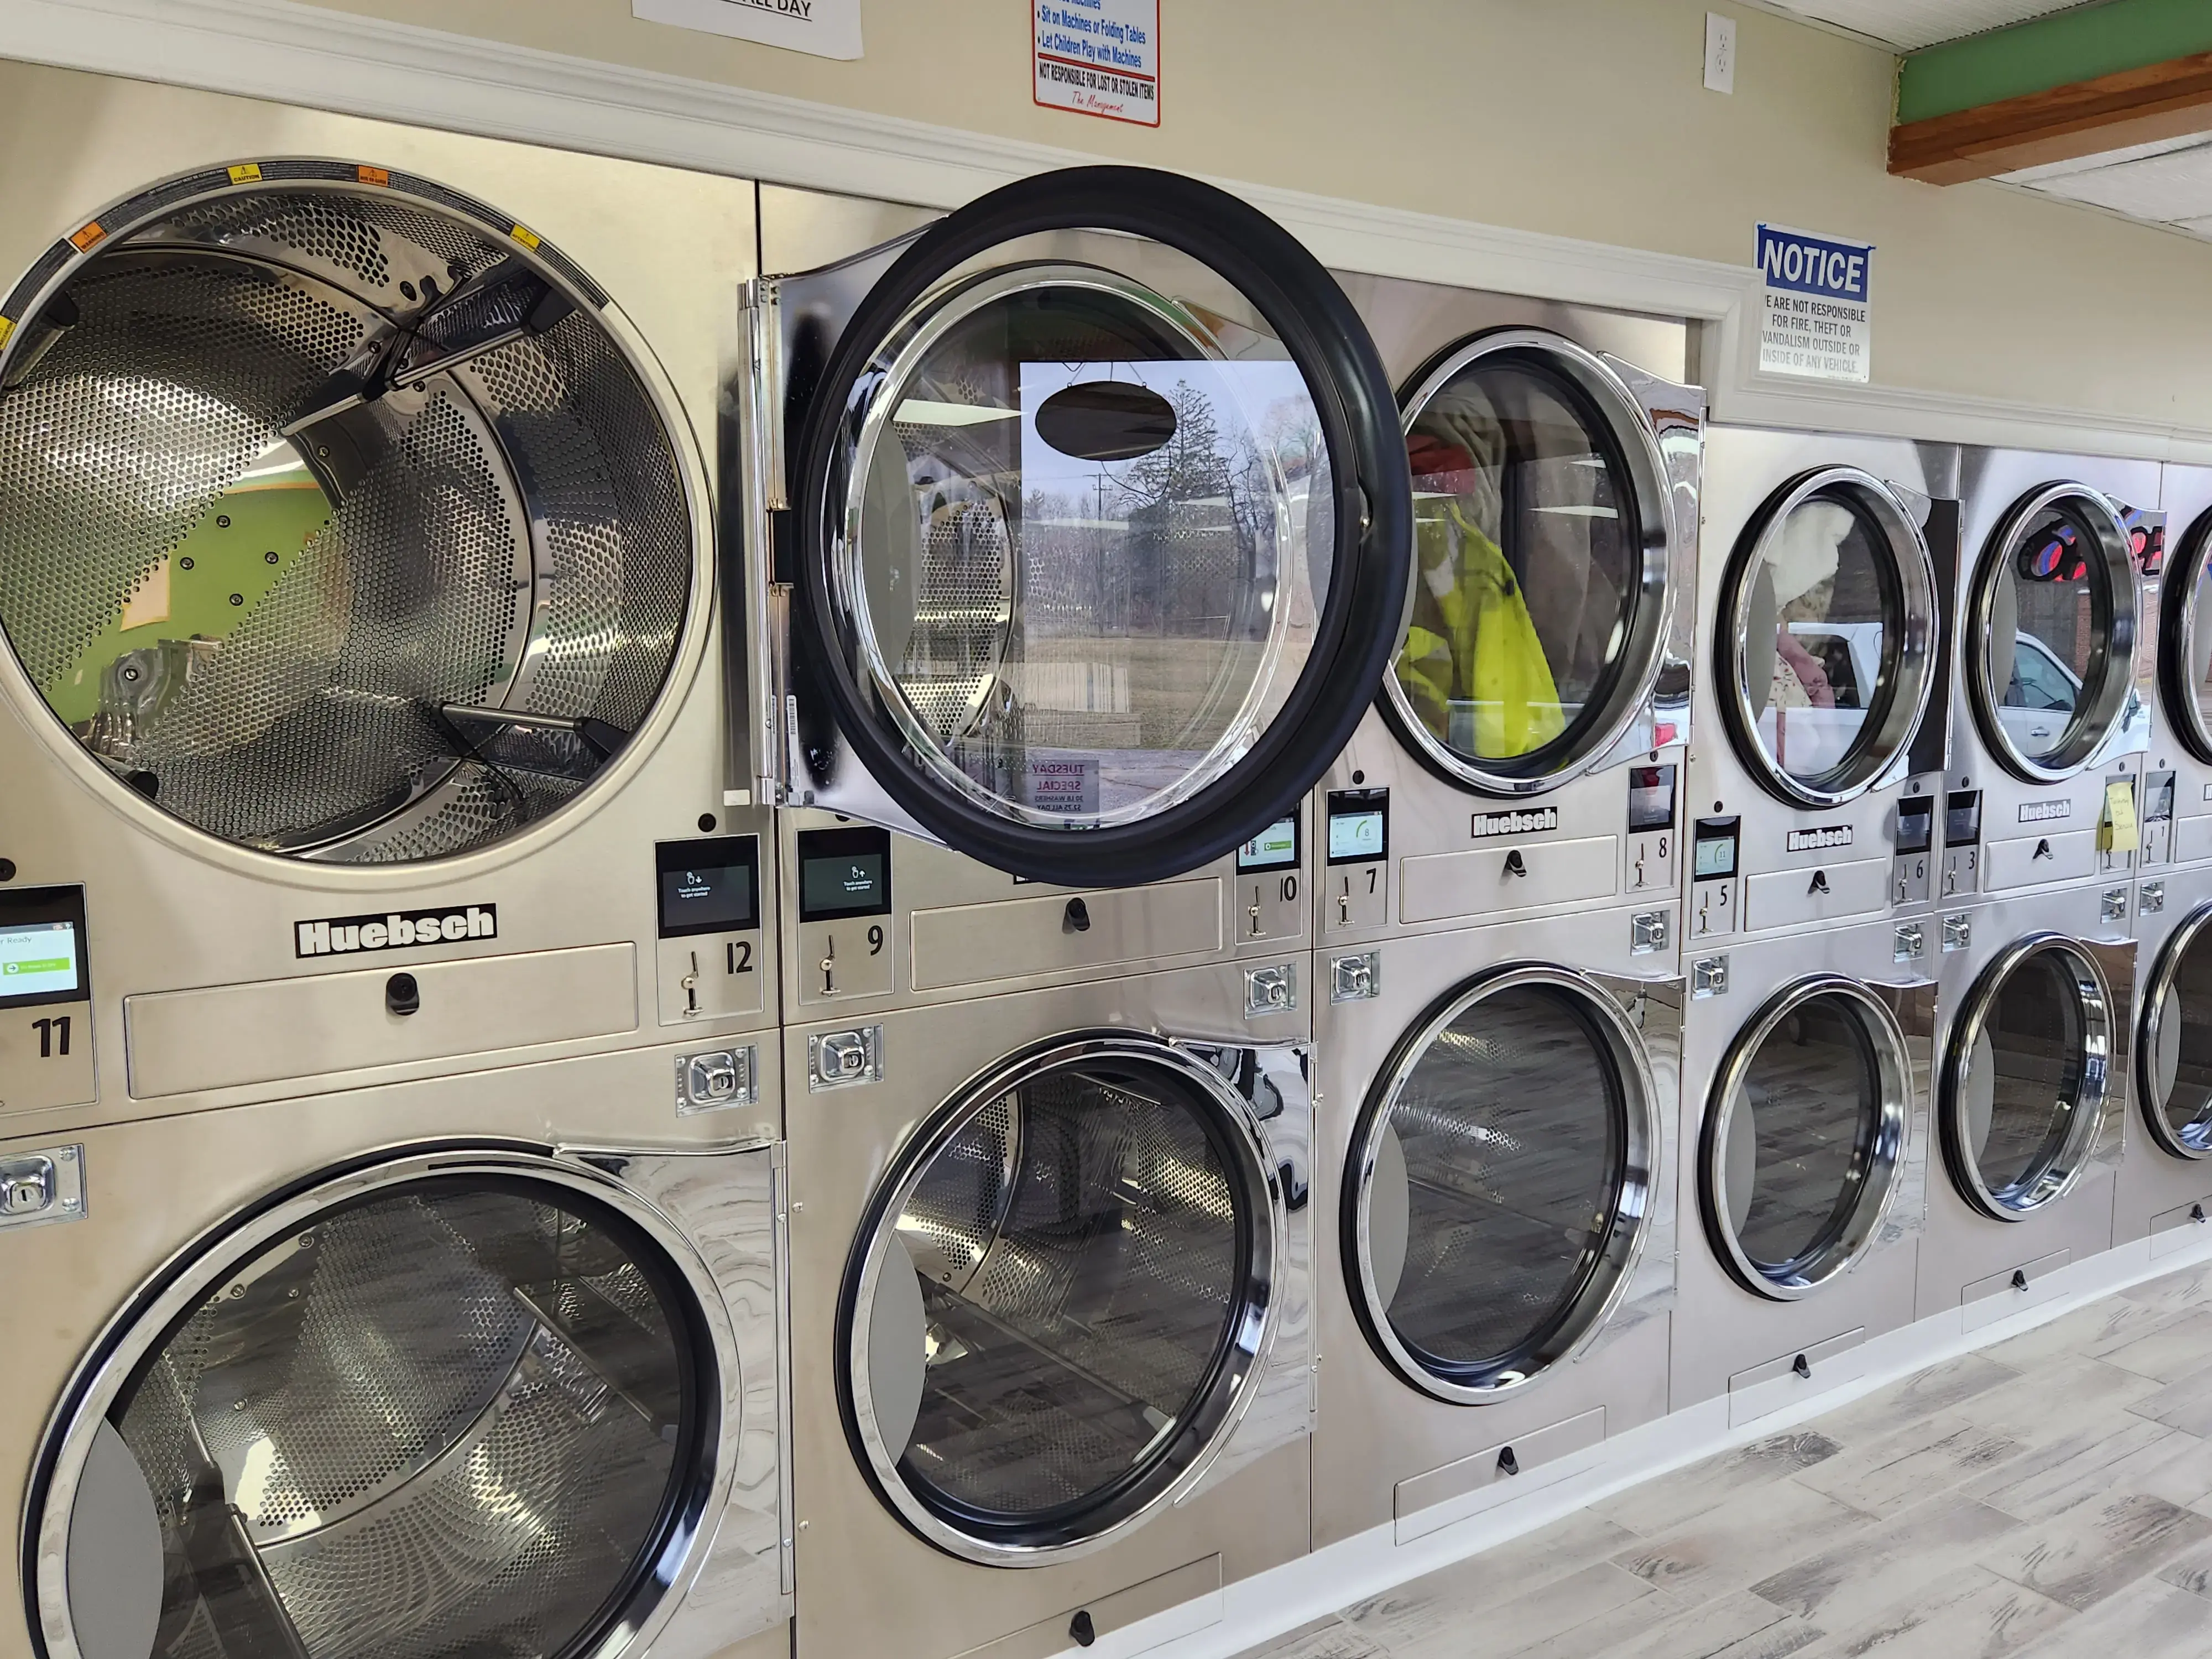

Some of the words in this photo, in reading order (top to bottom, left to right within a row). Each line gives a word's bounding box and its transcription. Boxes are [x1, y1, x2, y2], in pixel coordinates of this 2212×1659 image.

[778, 0, 811, 17] DAY
[1042, 4, 1051, 23] Sit
[1052, 12, 1060, 25] on
[1062, 9, 1092, 33] Machines
[1093, 21, 1099, 35] or
[1101, 19, 1124, 44] Folding
[1125, 24, 1145, 44] Tables
[1042, 30, 1052, 49] Let
[1055, 33, 1080, 55] Children
[1082, 39, 1095, 62] Play
[1097, 44, 1110, 62] with
[1112, 46, 1141, 68] Machines
[1039, 61, 1050, 80] NOT
[1051, 64, 1086, 87] RESPONSIBLE
[1087, 72, 1096, 90] FOR
[1098, 74, 1110, 92] LOST
[1112, 76, 1119, 93] OR
[1119, 79, 1138, 97] STOLEN
[1139, 83, 1154, 101] ITEMS
[1073, 91, 1084, 105] The
[1087, 95, 1124, 114] Management
[1763, 239, 1864, 293] NOTICE
[1773, 296, 1791, 311] ARE
[1793, 299, 1809, 314] NOT
[1811, 302, 1866, 322] RESPONSIBLE
[1772, 314, 1788, 328] FOR
[1791, 317, 1811, 333] FIRE,
[1814, 320, 1838, 336] THEFT
[1840, 325, 1851, 337] OR
[1762, 330, 1810, 349] VANDALISM
[1813, 338, 1846, 354] OUTSIDE
[1849, 343, 1860, 356] OR
[1762, 349, 1791, 365] INSIDE
[1793, 353, 1804, 366] OF
[1806, 354, 1822, 369] ANY
[1474, 808, 1556, 836] Huebsch
[2020, 801, 2069, 821] Huebsch
[1365, 828, 1369, 836] 8
[1788, 826, 1852, 851] Huebsch
[2161, 826, 2165, 837] 1
[1659, 837, 1667, 858] 8
[1969, 852, 1975, 869] 3
[1366, 868, 1376, 894] 7
[1917, 860, 1923, 878] 6
[1280, 875, 1297, 902] 10
[1720, 885, 1727, 906] 5
[299, 907, 494, 955] Huebsch
[868, 925, 883, 956] 9
[727, 941, 752, 974] 12
[32, 1016, 70, 1057] 11
